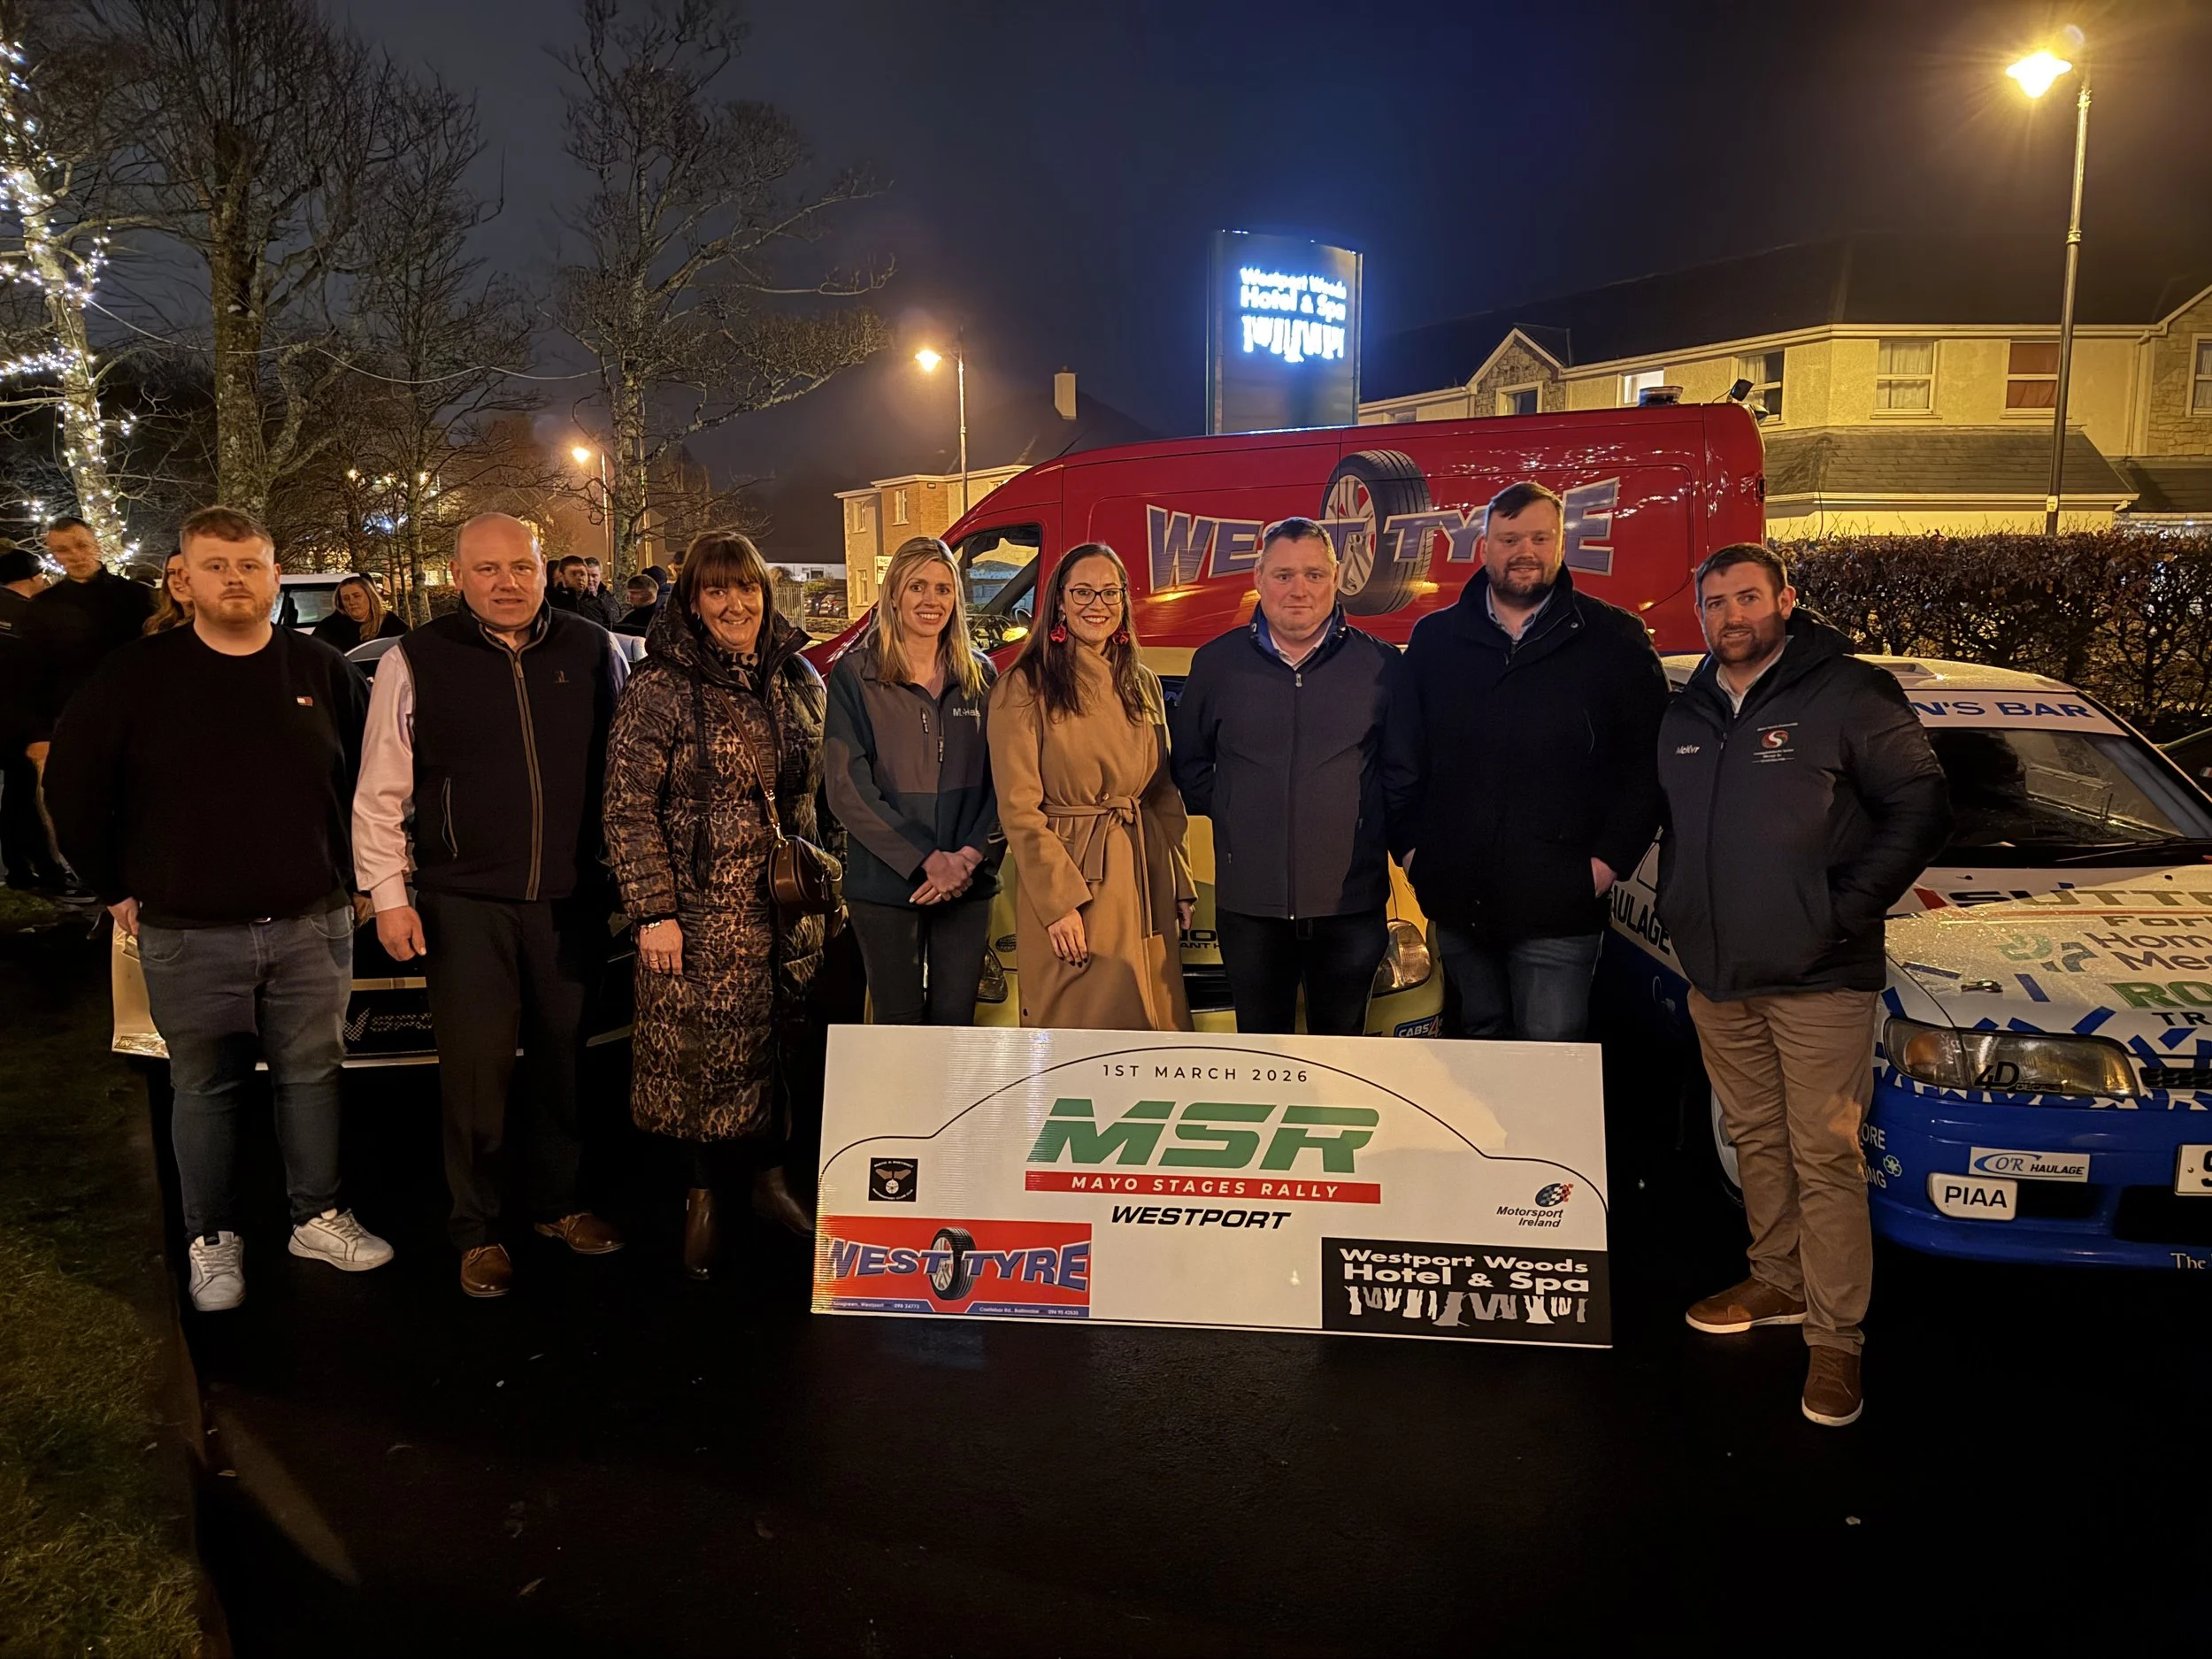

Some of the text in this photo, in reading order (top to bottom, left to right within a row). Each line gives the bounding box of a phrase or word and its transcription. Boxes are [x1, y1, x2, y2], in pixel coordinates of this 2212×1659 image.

[1240, 285, 1346, 322] Hotel & Spa
[1147, 477, 1620, 594] WET TYE
[1994, 703, 2095, 718] BAR
[2101, 914, 2212, 926] For
[2109, 951, 2212, 971] Me
[1103, 1064, 1307, 1082] 1ST MARCH 2026
[2016, 1083, 2061, 1093] DECA
[1026, 1098, 1379, 1173] MSR
[2031, 1164, 2085, 1175] HAULAGE
[1071, 1176, 1338, 1198] MAYO STAGES RALLY
[1945, 1186, 2008, 1208] PIAA
[1111, 1206, 1292, 1229] WESTPORT
[1496, 1206, 1563, 1219] Motorsport
[1518, 1217, 1561, 1228] Ireland
[826, 1239, 1090, 1291] WEST TYRE
[1339, 1248, 1588, 1273] Westport Woods
[2170, 1253, 2206, 1270] The
[1344, 1263, 1589, 1294] Hotel & Spa
